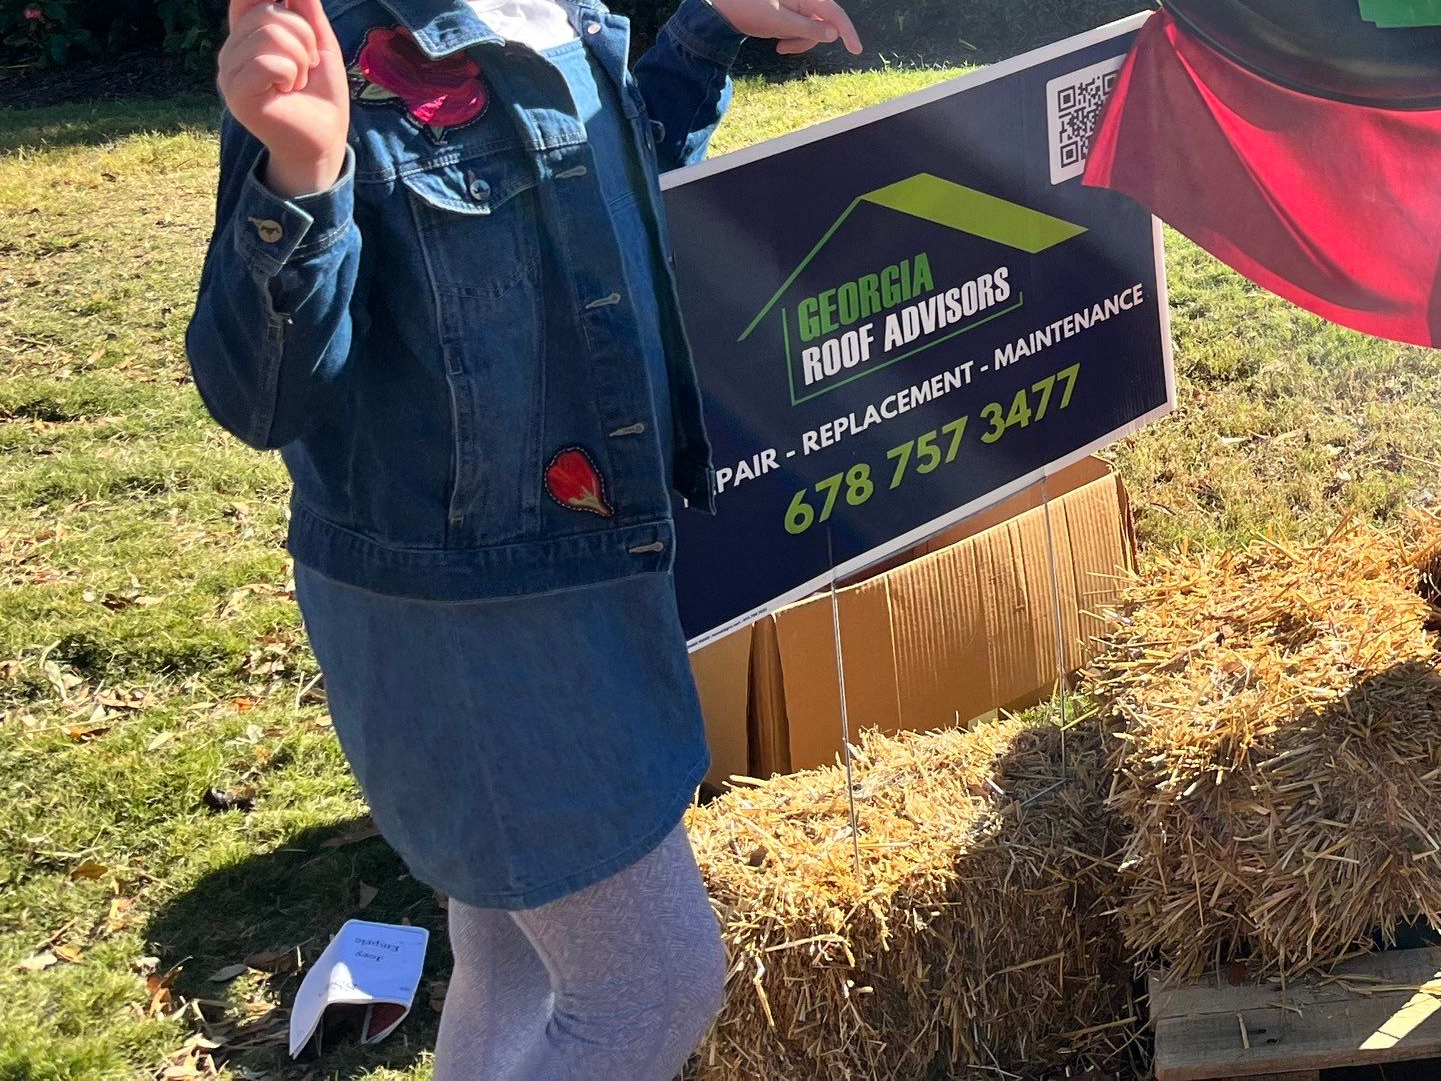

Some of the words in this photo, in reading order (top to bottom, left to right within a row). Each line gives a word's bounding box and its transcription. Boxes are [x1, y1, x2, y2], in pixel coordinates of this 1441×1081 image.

[797, 252, 934, 342] GEORGIA
[801, 323, 875, 386] ROOF
[883, 266, 1011, 353] ADVISORS
[690, 447, 780, 506] PAIR
[802, 360, 974, 456] REPLACEMENT
[994, 282, 1145, 372] MAINTENANCE
[783, 462, 875, 536] 678
[886, 415, 969, 490] 757
[980, 363, 1082, 444] 3477
